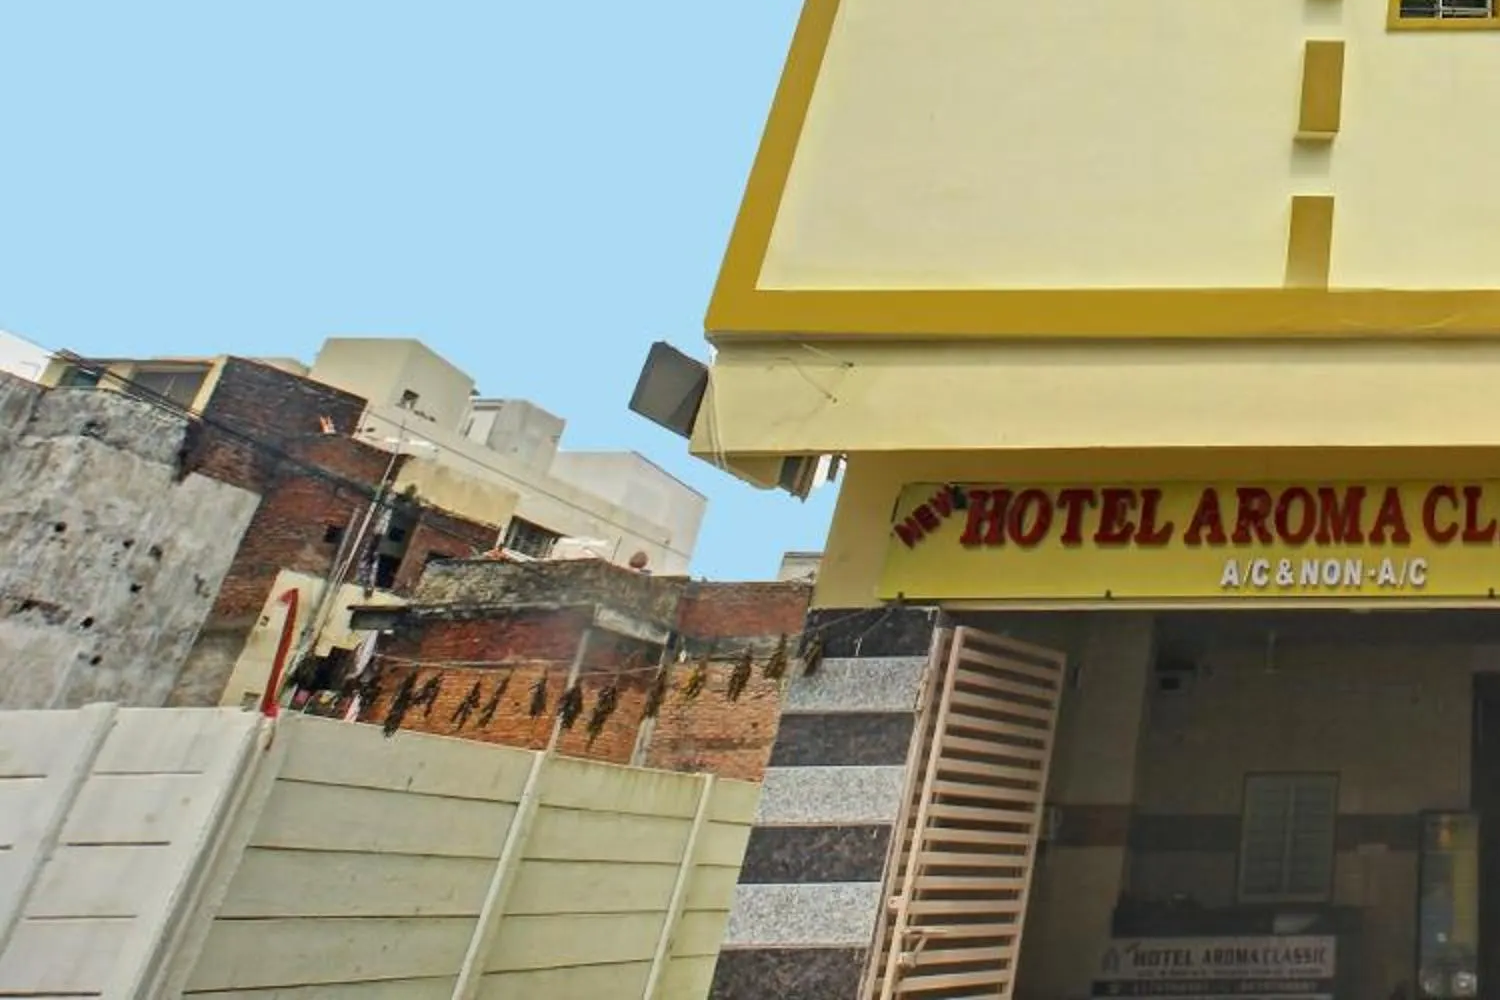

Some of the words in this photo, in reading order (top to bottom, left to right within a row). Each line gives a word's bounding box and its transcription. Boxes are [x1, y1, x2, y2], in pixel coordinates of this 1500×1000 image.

[960, 488, 1174, 546] HOTEL
[1184, 487, 1411, 544] AROMA
[1134, 947, 1194, 967] HOTEL
